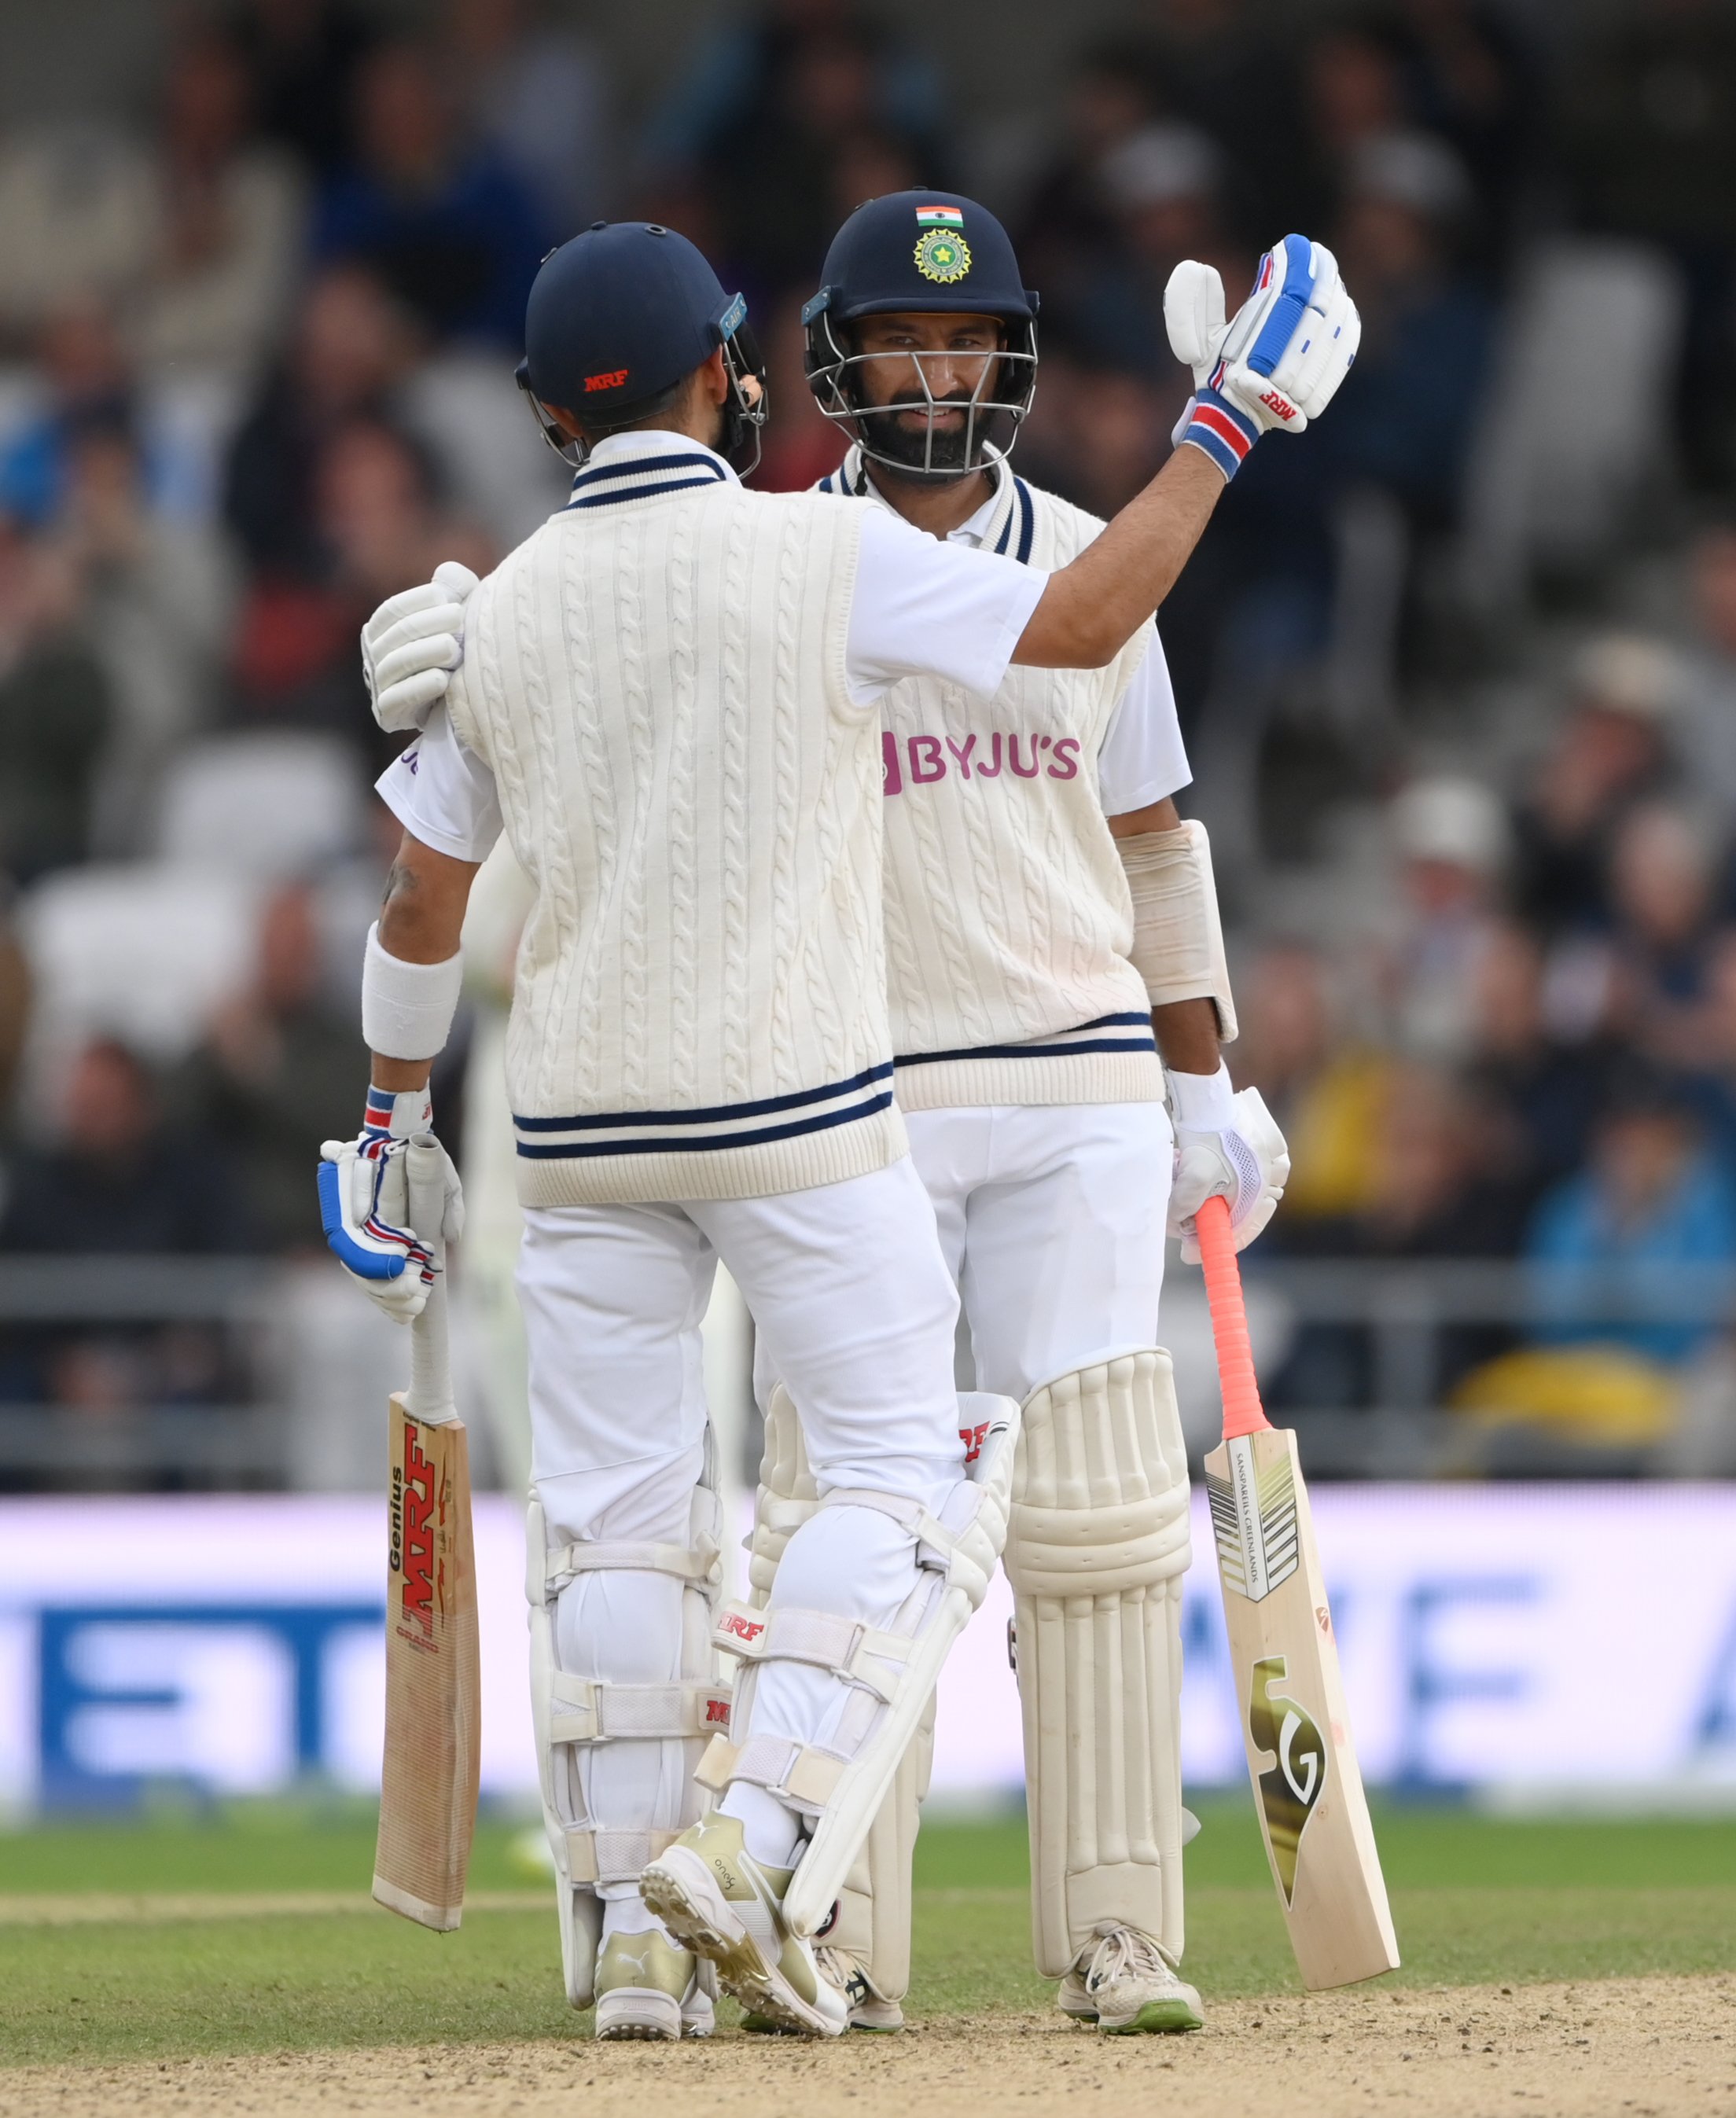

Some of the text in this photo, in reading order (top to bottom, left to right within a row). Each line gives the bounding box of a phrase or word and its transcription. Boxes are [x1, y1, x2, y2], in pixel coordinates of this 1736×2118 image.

[583, 369, 628, 392] MRF
[1259, 389, 1297, 421] MRF
[907, 732, 1080, 784] BYJU'S
[390, 1465, 402, 1572] Genius
[403, 1422, 435, 1640] MRF
[1236, 1453, 1258, 1583] SANSPAREILS GREENLANDS
